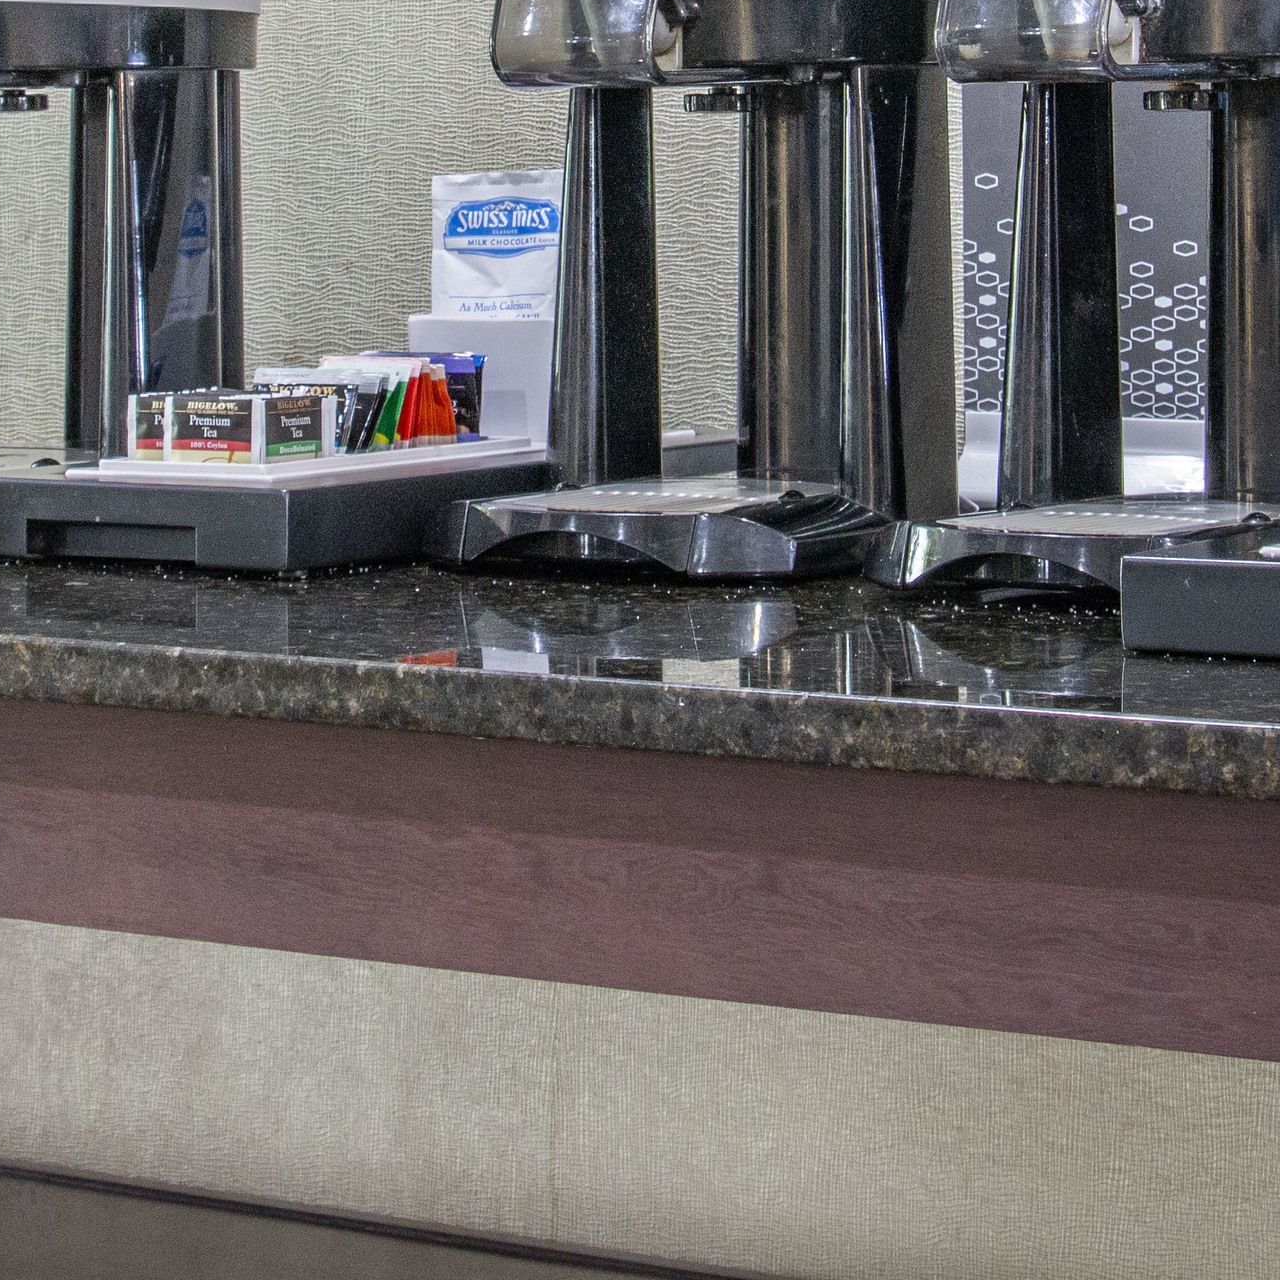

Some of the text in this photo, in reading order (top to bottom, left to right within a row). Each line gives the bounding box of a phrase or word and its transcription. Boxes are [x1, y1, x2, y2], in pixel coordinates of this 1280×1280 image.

[490, 237, 536, 246] CHOCOLATE
[459, 301, 532, 312] As Much Calcium
[187, 401, 236, 411] BIGELOW
[189, 415, 230, 427] Premium
[281, 415, 311, 427] Premium
[202, 427, 217, 438] Tea
[290, 427, 303, 439] Tea
